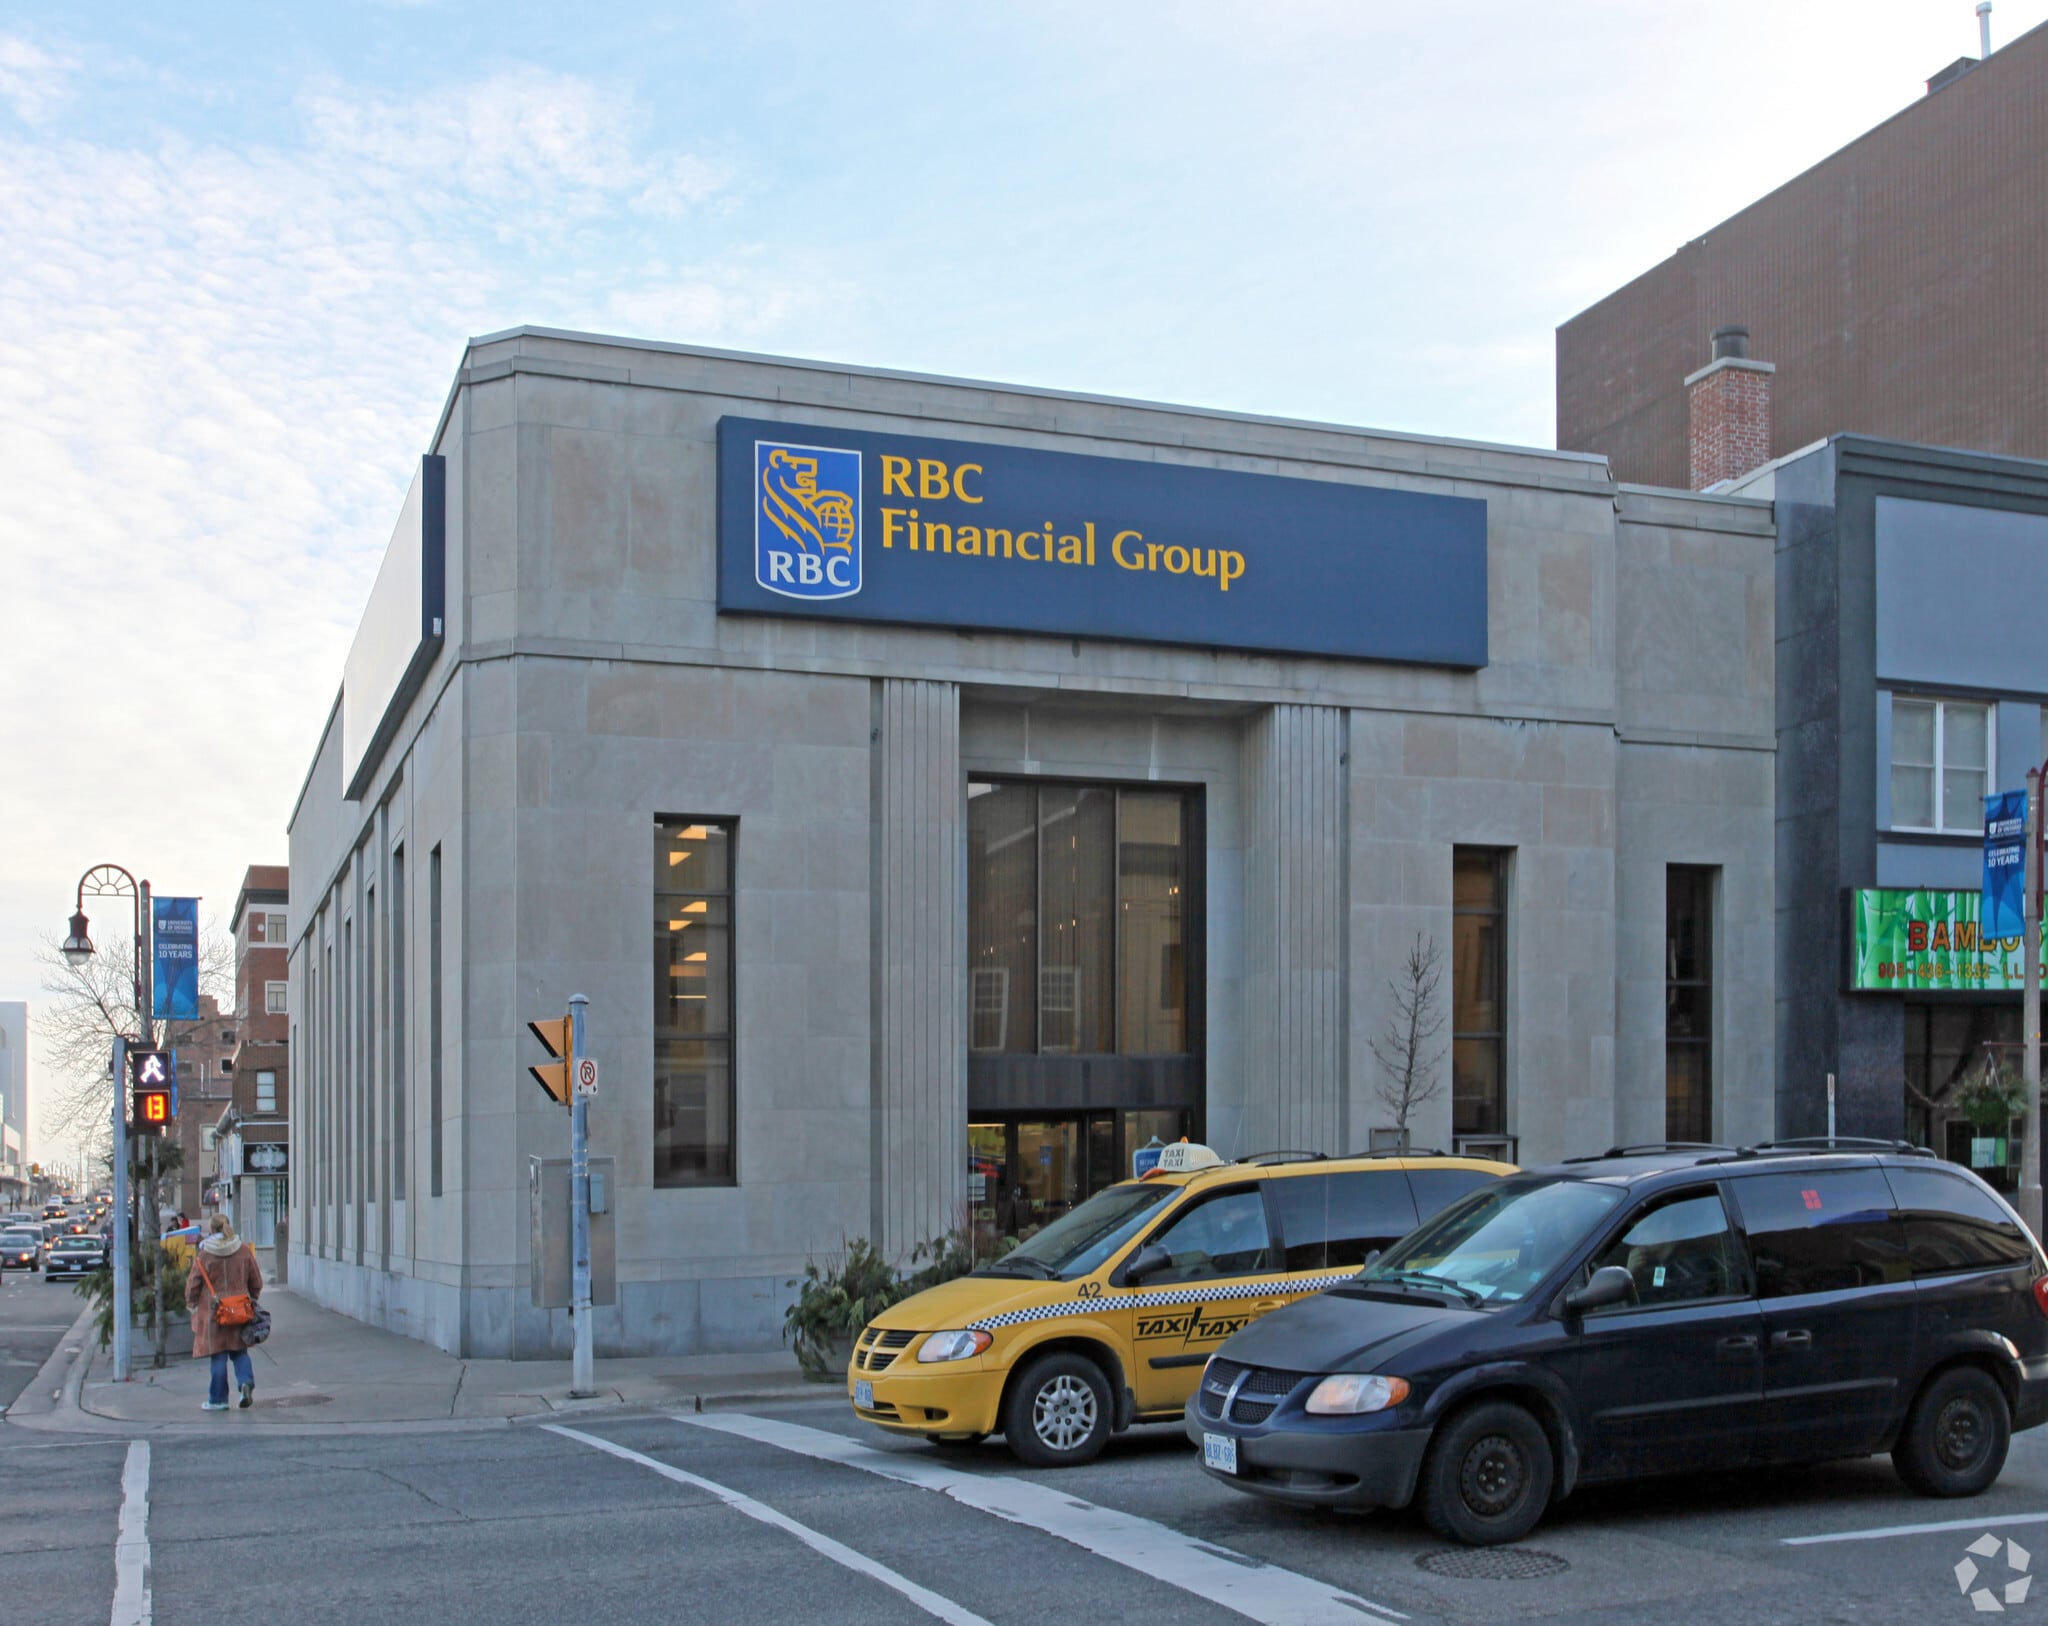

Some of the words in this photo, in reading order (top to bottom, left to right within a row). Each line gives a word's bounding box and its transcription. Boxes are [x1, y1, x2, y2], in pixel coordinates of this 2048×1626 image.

[880, 455, 983, 504] RBC
[880, 508, 1095, 565] Financial
[1112, 531, 1246, 591] Group
[768, 550, 851, 588] RBC
[1988, 858, 1996, 868] 10
[1997, 853, 2019, 866] YEARS
[1908, 921, 2044, 953] BAMBO
[158, 950, 168, 959] 10
[168, 950, 193, 959] YEARS
[1878, 962, 1990, 980] 905-436-1332
[146, 1094, 165, 1121] 13
[1163, 1158, 1184, 1168] TAXI
[1164, 1148, 1185, 1158] TAXI
[1077, 1281, 1104, 1300] 42
[1136, 1316, 1189, 1337] TAXI
